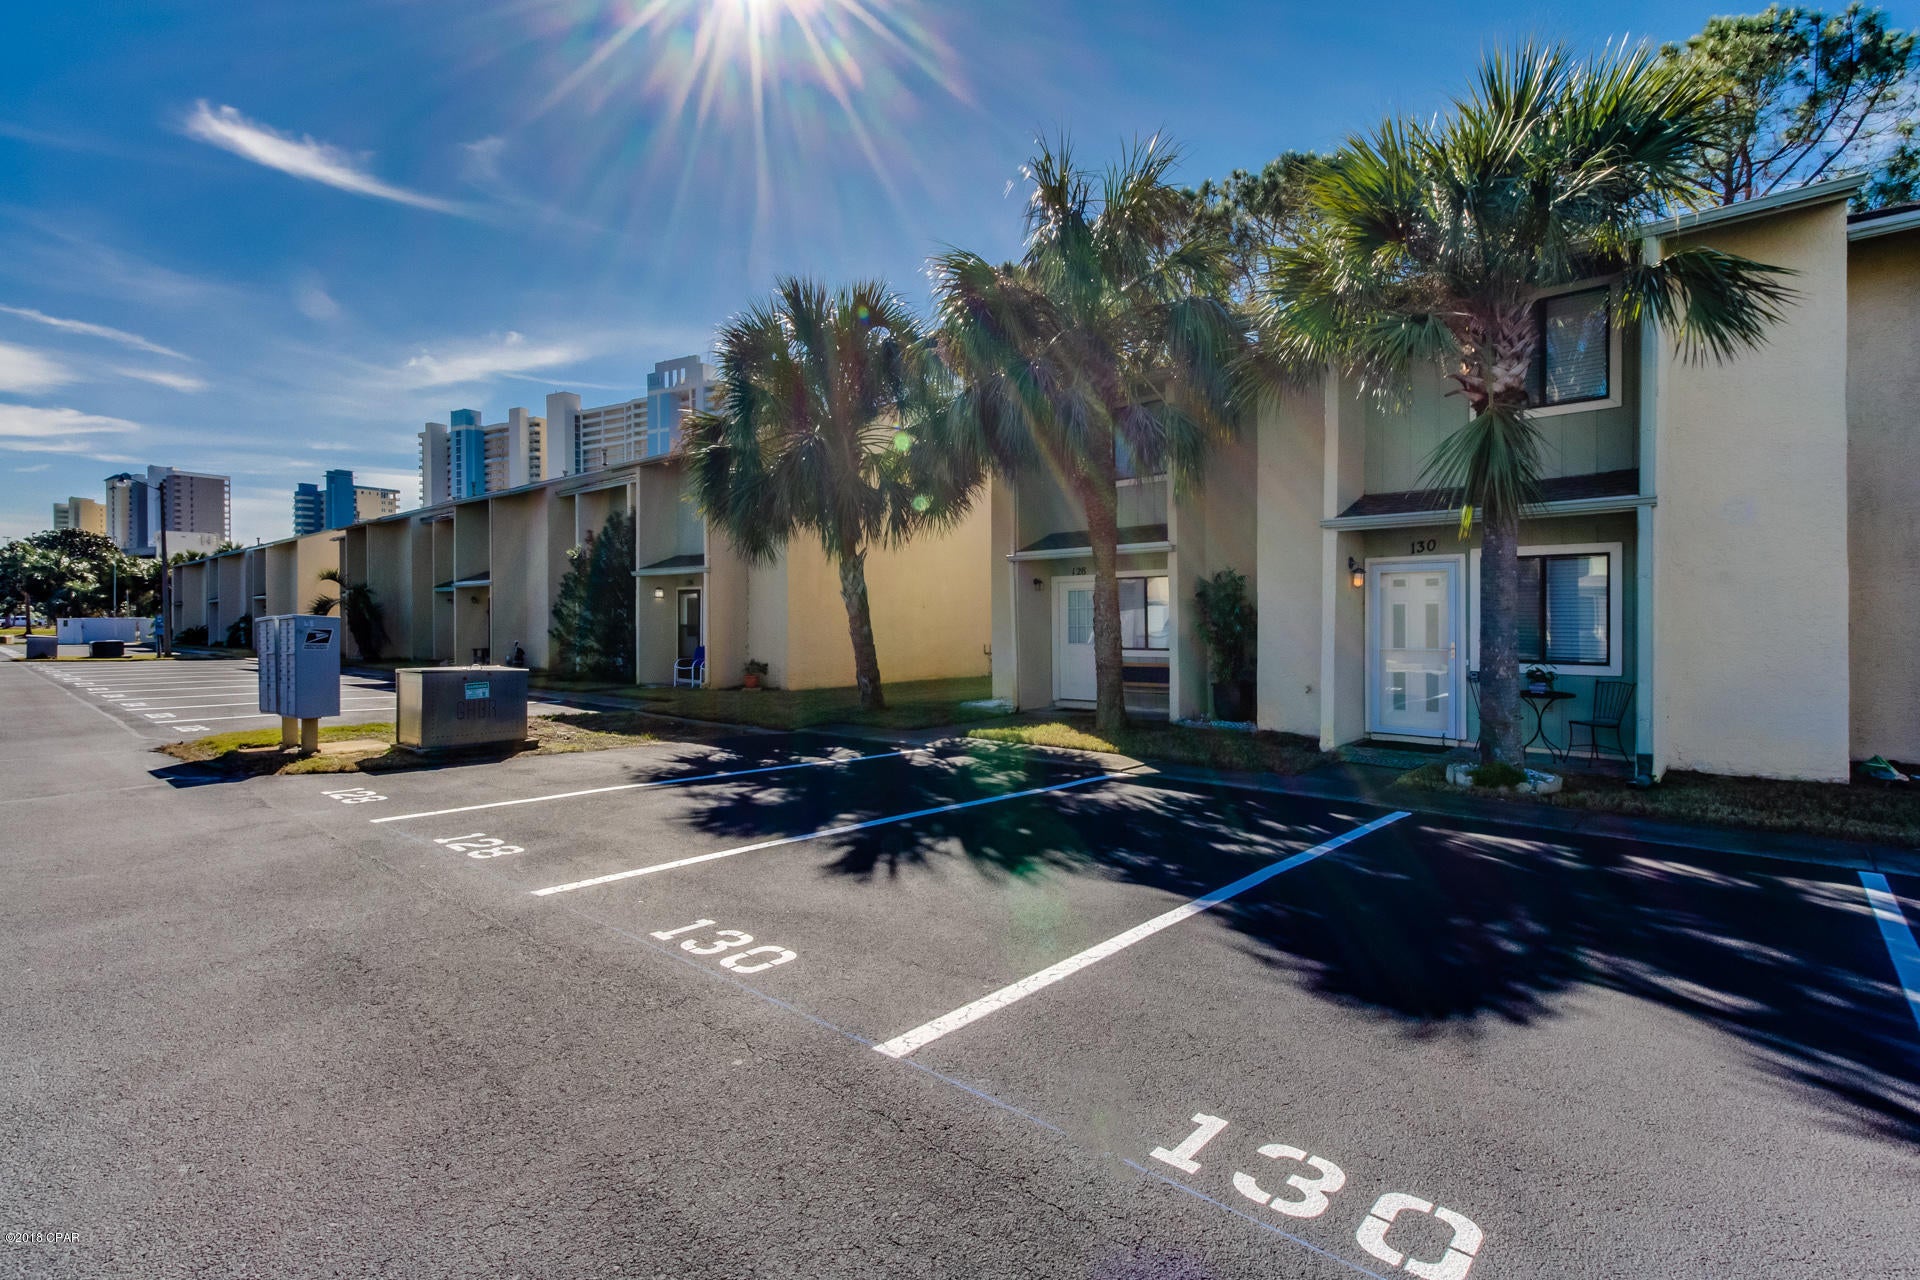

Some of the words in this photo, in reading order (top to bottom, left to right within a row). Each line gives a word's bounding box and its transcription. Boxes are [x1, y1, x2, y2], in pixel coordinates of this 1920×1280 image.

[1411, 539, 1436, 554] 130
[1072, 567, 1087, 576] 128
[320, 787, 388, 804] 128
[433, 832, 525, 859] 128
[650, 918, 797, 973] 130
[1150, 1112, 1484, 1280] 130
